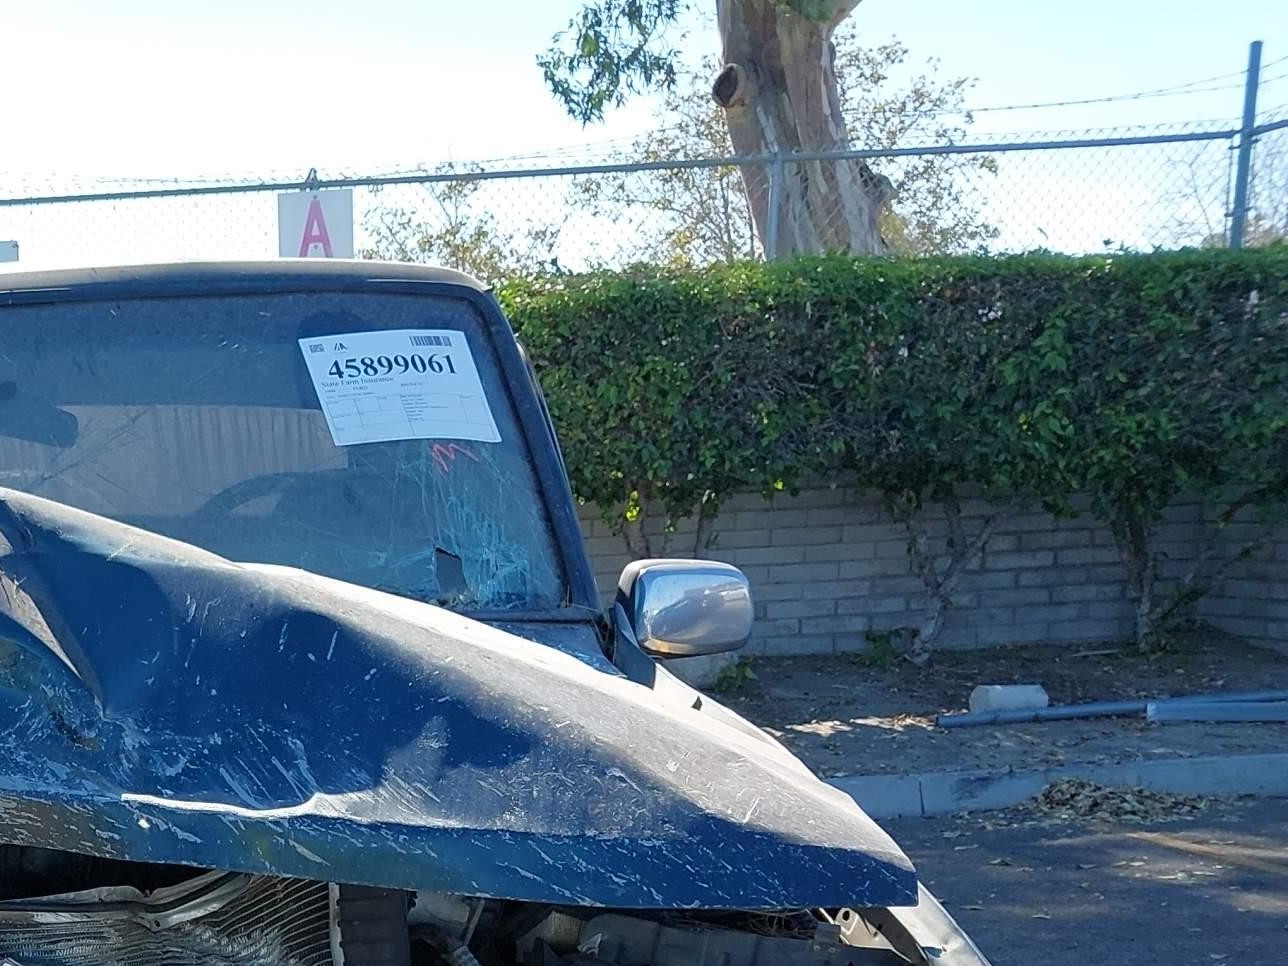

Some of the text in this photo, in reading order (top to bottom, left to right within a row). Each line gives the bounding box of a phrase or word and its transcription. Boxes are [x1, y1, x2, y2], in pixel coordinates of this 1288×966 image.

[298, 200, 334, 257] A
[328, 353, 457, 379] 45899061
[322, 379, 340, 387] State
[341, 378, 359, 386] Farm
